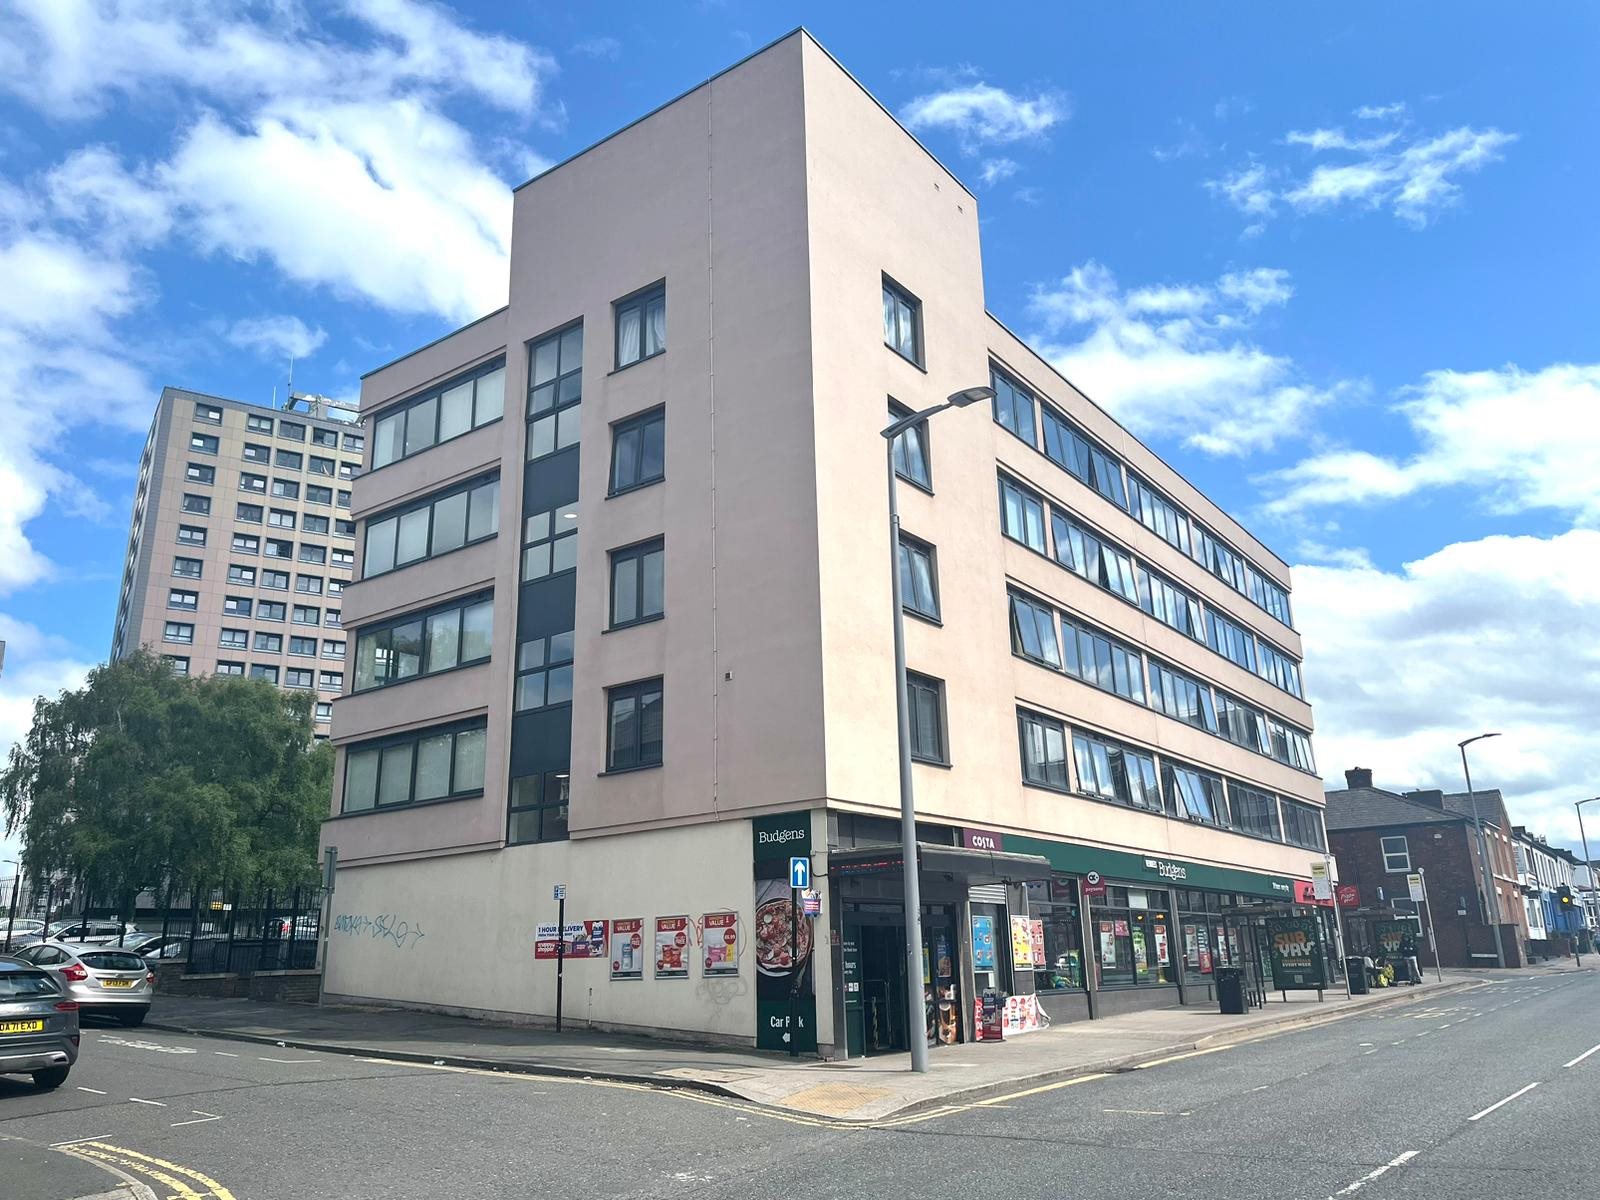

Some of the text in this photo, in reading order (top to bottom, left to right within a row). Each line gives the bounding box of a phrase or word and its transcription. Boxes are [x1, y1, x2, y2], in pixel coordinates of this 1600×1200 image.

[759, 829, 805, 844] Budgens
[972, 835, 995, 849] COSTA
[1158, 862, 1186, 880] Budgens
[557, 925, 584, 933] LIVERY
[1274, 931, 1307, 948] SUB
[1279, 941, 1313, 957] YAY
[770, 1015, 804, 1028] Car Pk
